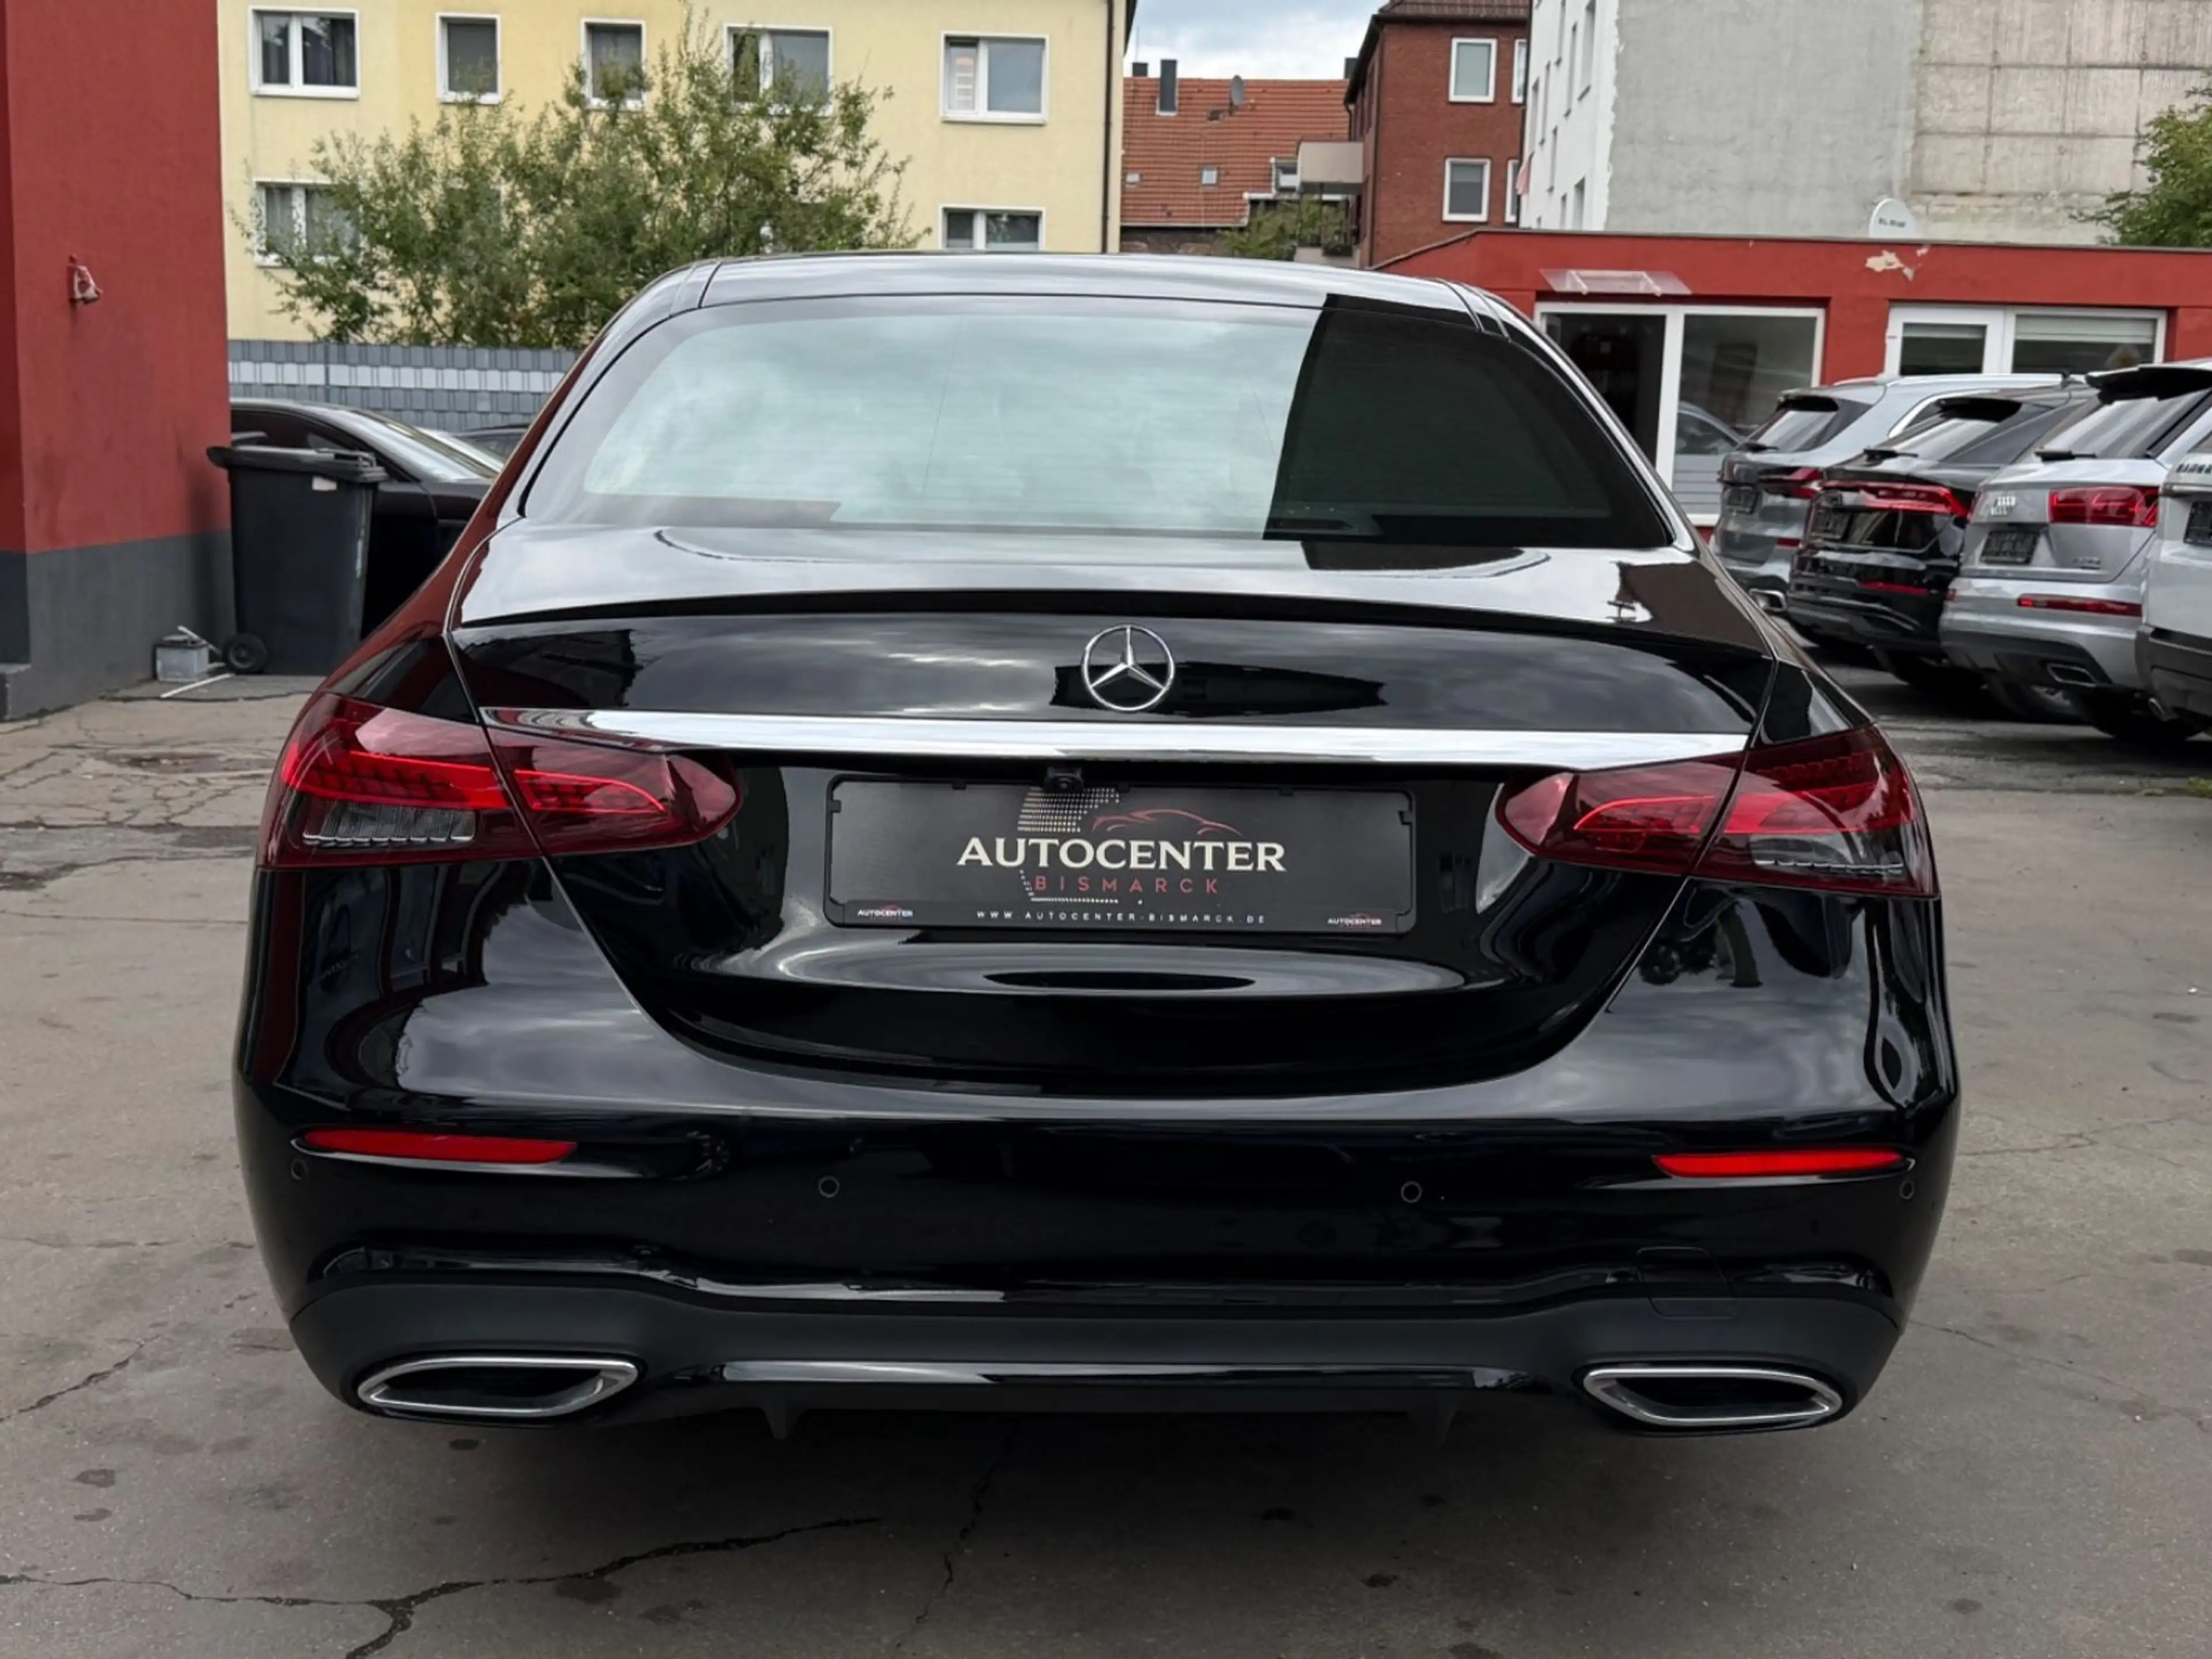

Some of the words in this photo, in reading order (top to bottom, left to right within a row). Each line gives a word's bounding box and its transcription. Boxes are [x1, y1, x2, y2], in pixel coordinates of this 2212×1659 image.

[956, 837, 1287, 872] AUTOCENTER
[1035, 875, 1218, 893] BISMARCK
[857, 909, 914, 918] AUTOCENTER
